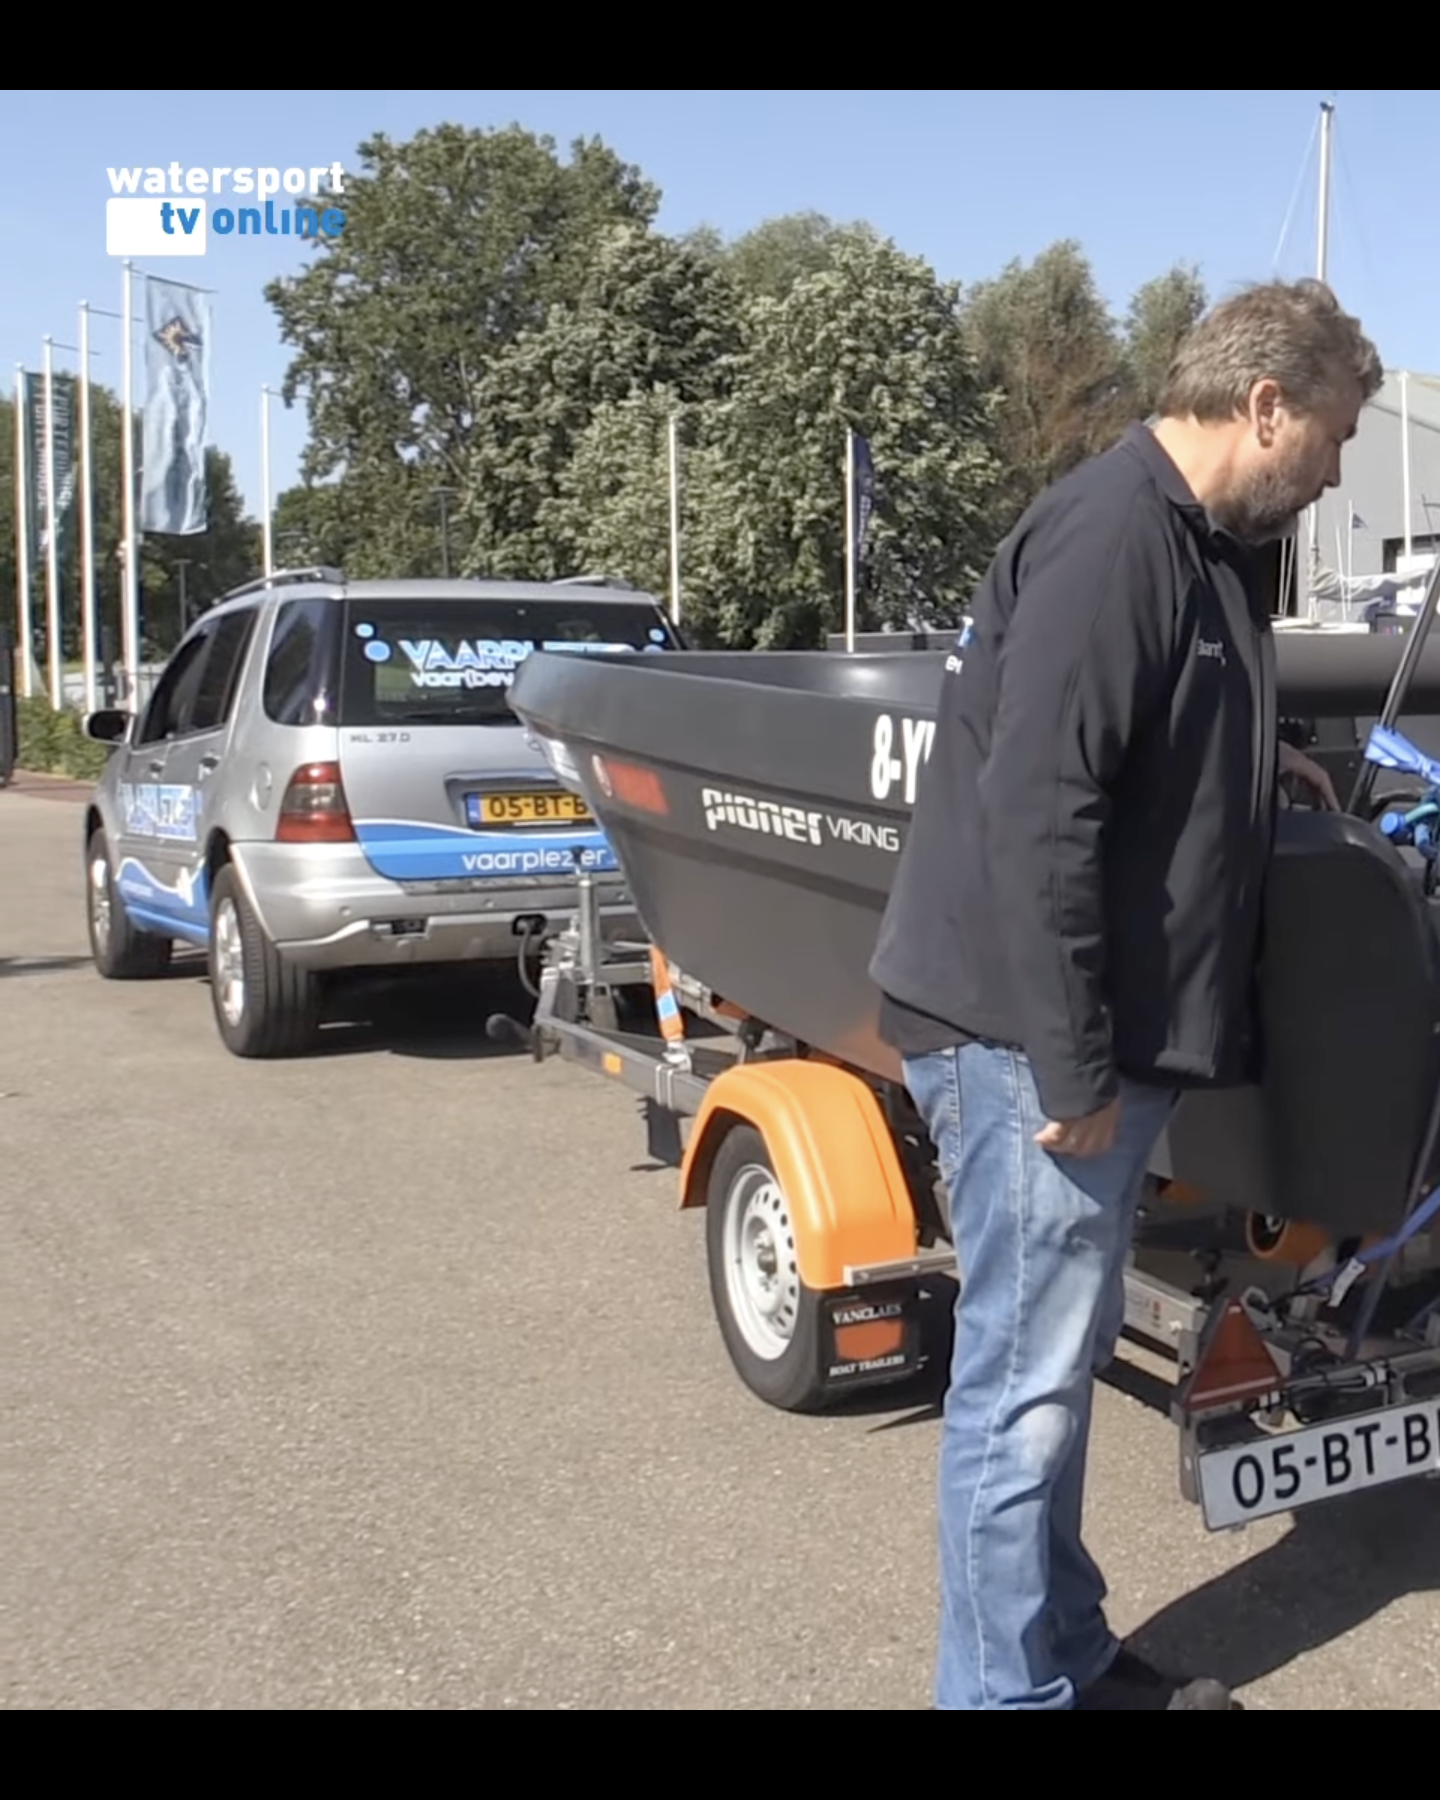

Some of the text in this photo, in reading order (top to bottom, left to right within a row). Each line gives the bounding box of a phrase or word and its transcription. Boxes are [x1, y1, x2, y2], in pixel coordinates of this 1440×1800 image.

[489, 795, 589, 818] 05-BT-B
[826, 815, 900, 852] VIKING
[829, 1363, 857, 1377] BOAT
